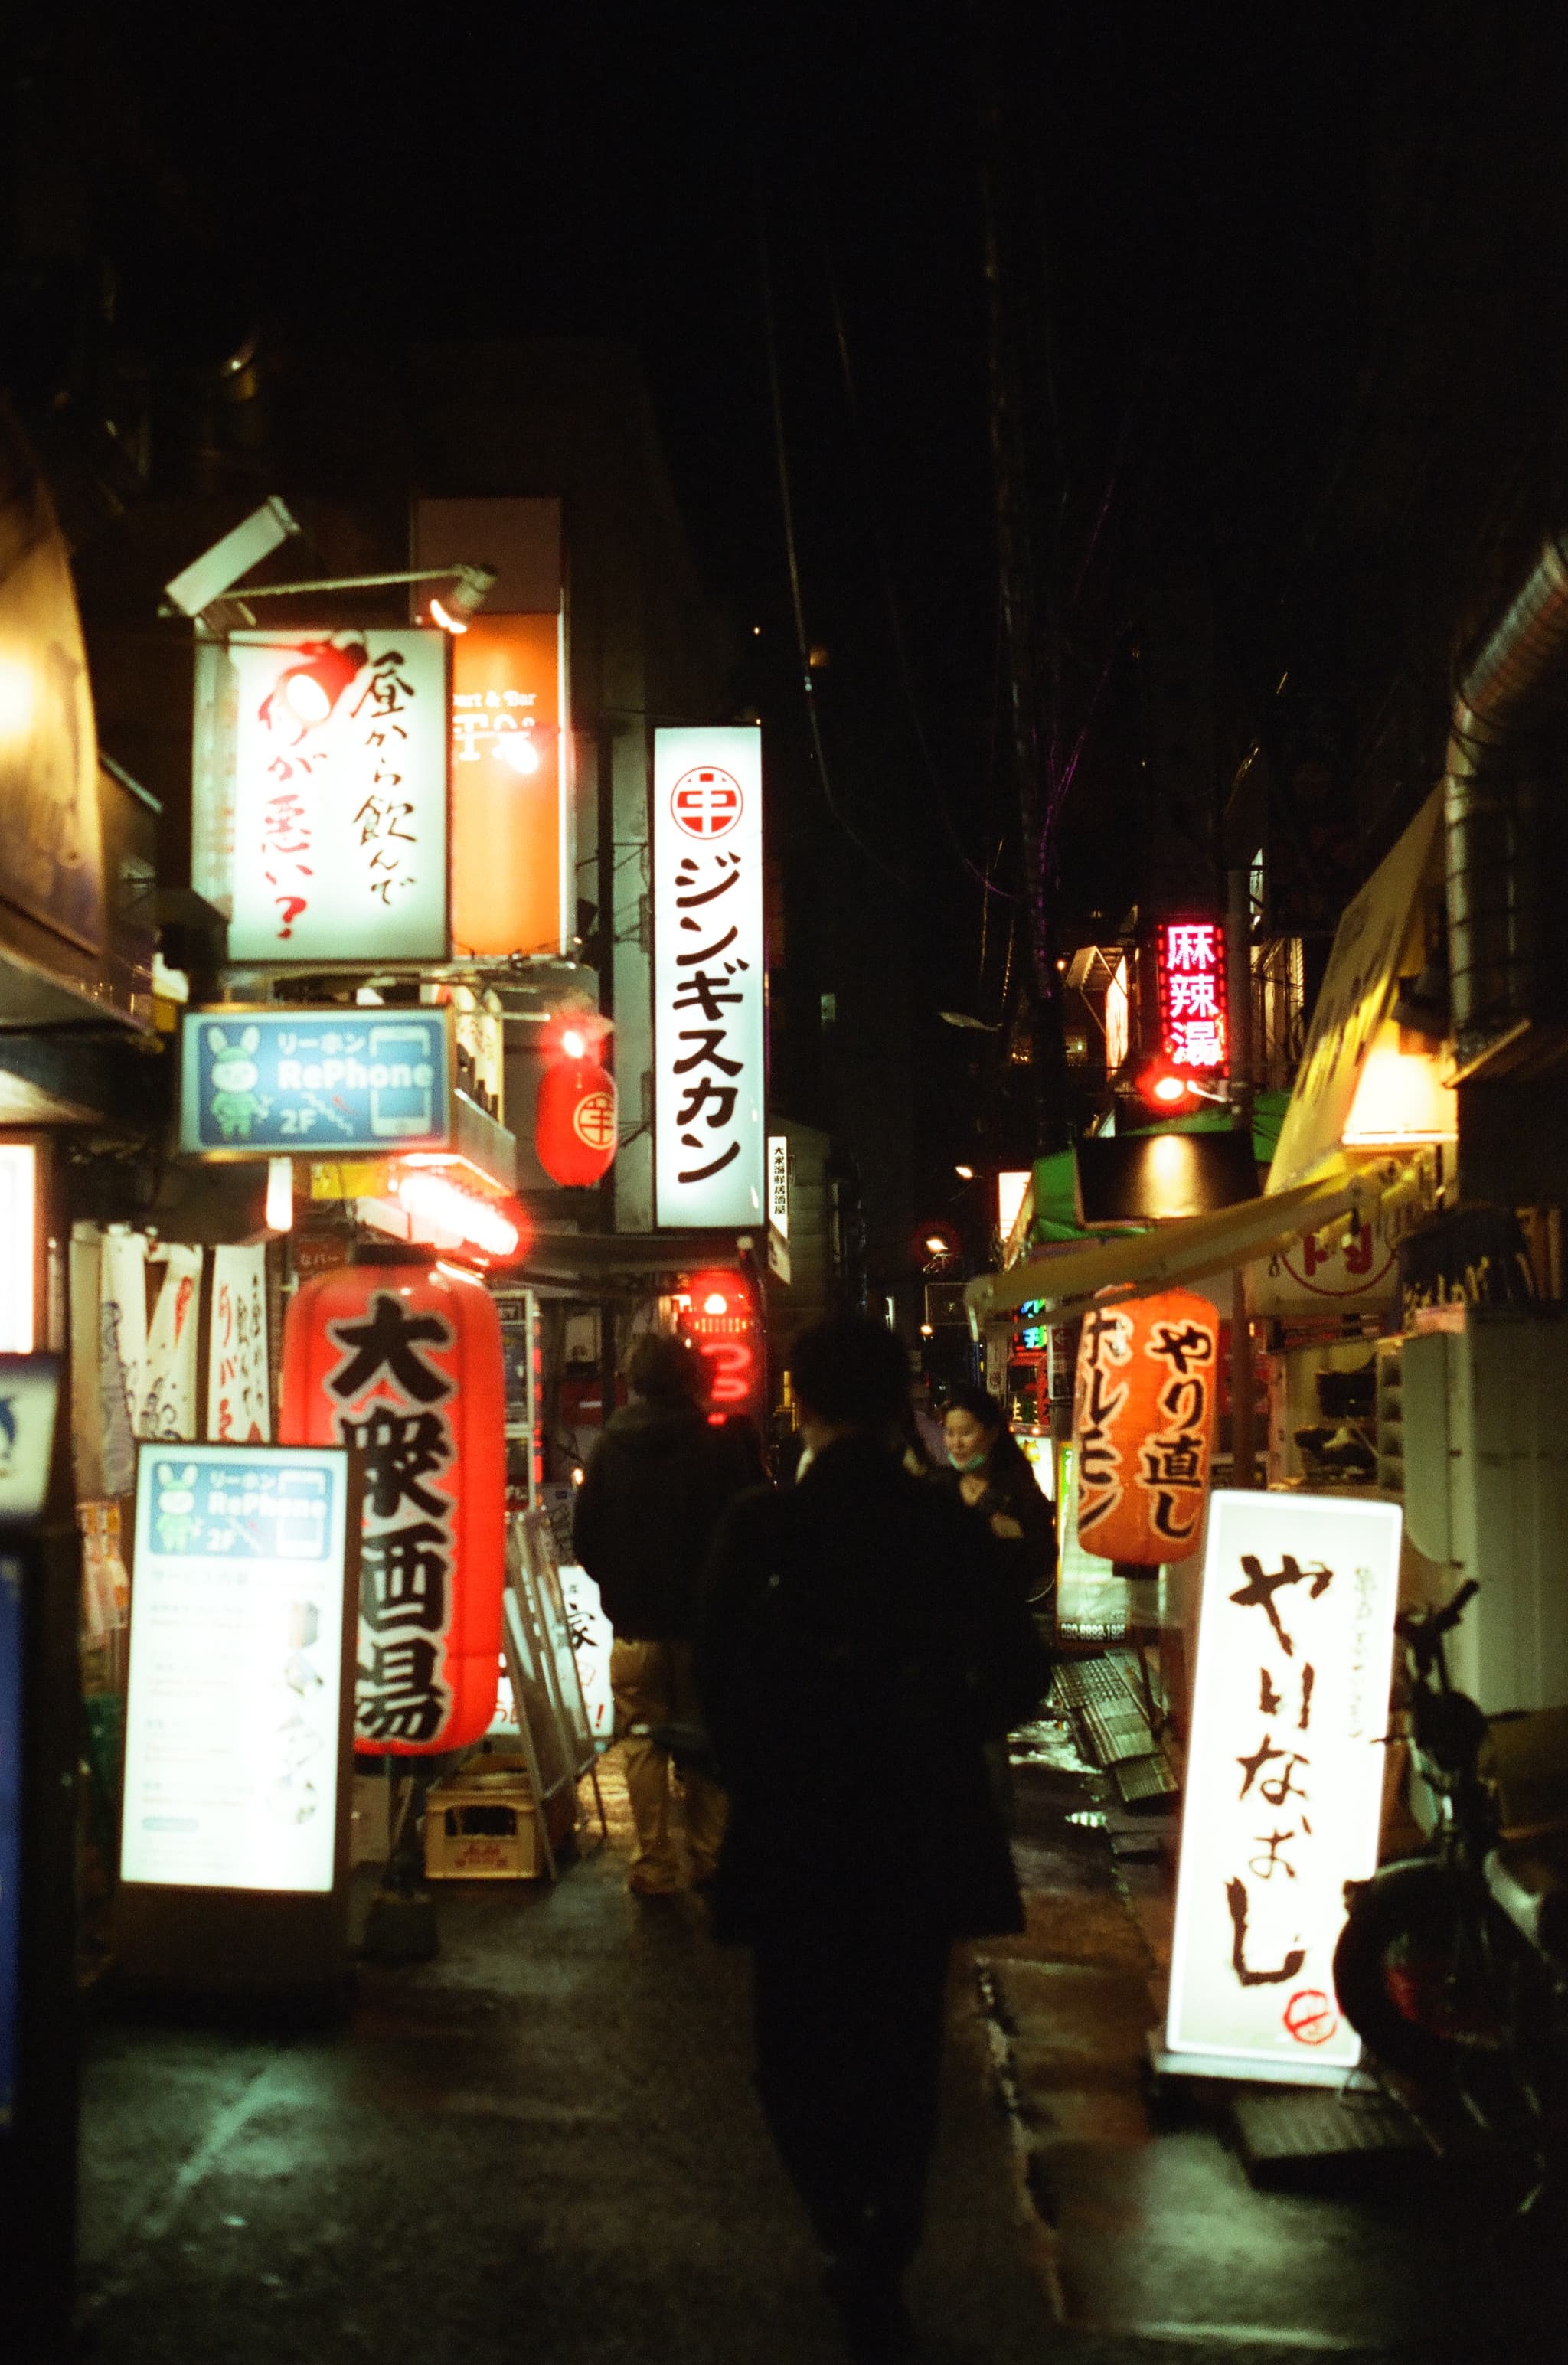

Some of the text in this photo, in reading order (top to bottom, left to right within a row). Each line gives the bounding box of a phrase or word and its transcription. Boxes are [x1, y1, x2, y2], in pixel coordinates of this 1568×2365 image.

[350, 651, 417, 905] 昼から飲んで
[277, 1031, 367, 1056] リーホン
[277, 1057, 434, 1091] RePhone
[672, 850, 750, 1184] ジンギスカン
[279, 1108, 318, 1135] 2F
[1142, 1322, 1214, 1539] やり直し
[207, 1490, 326, 1519] RePhone
[1227, 1554, 1334, 1987] やりなおし
